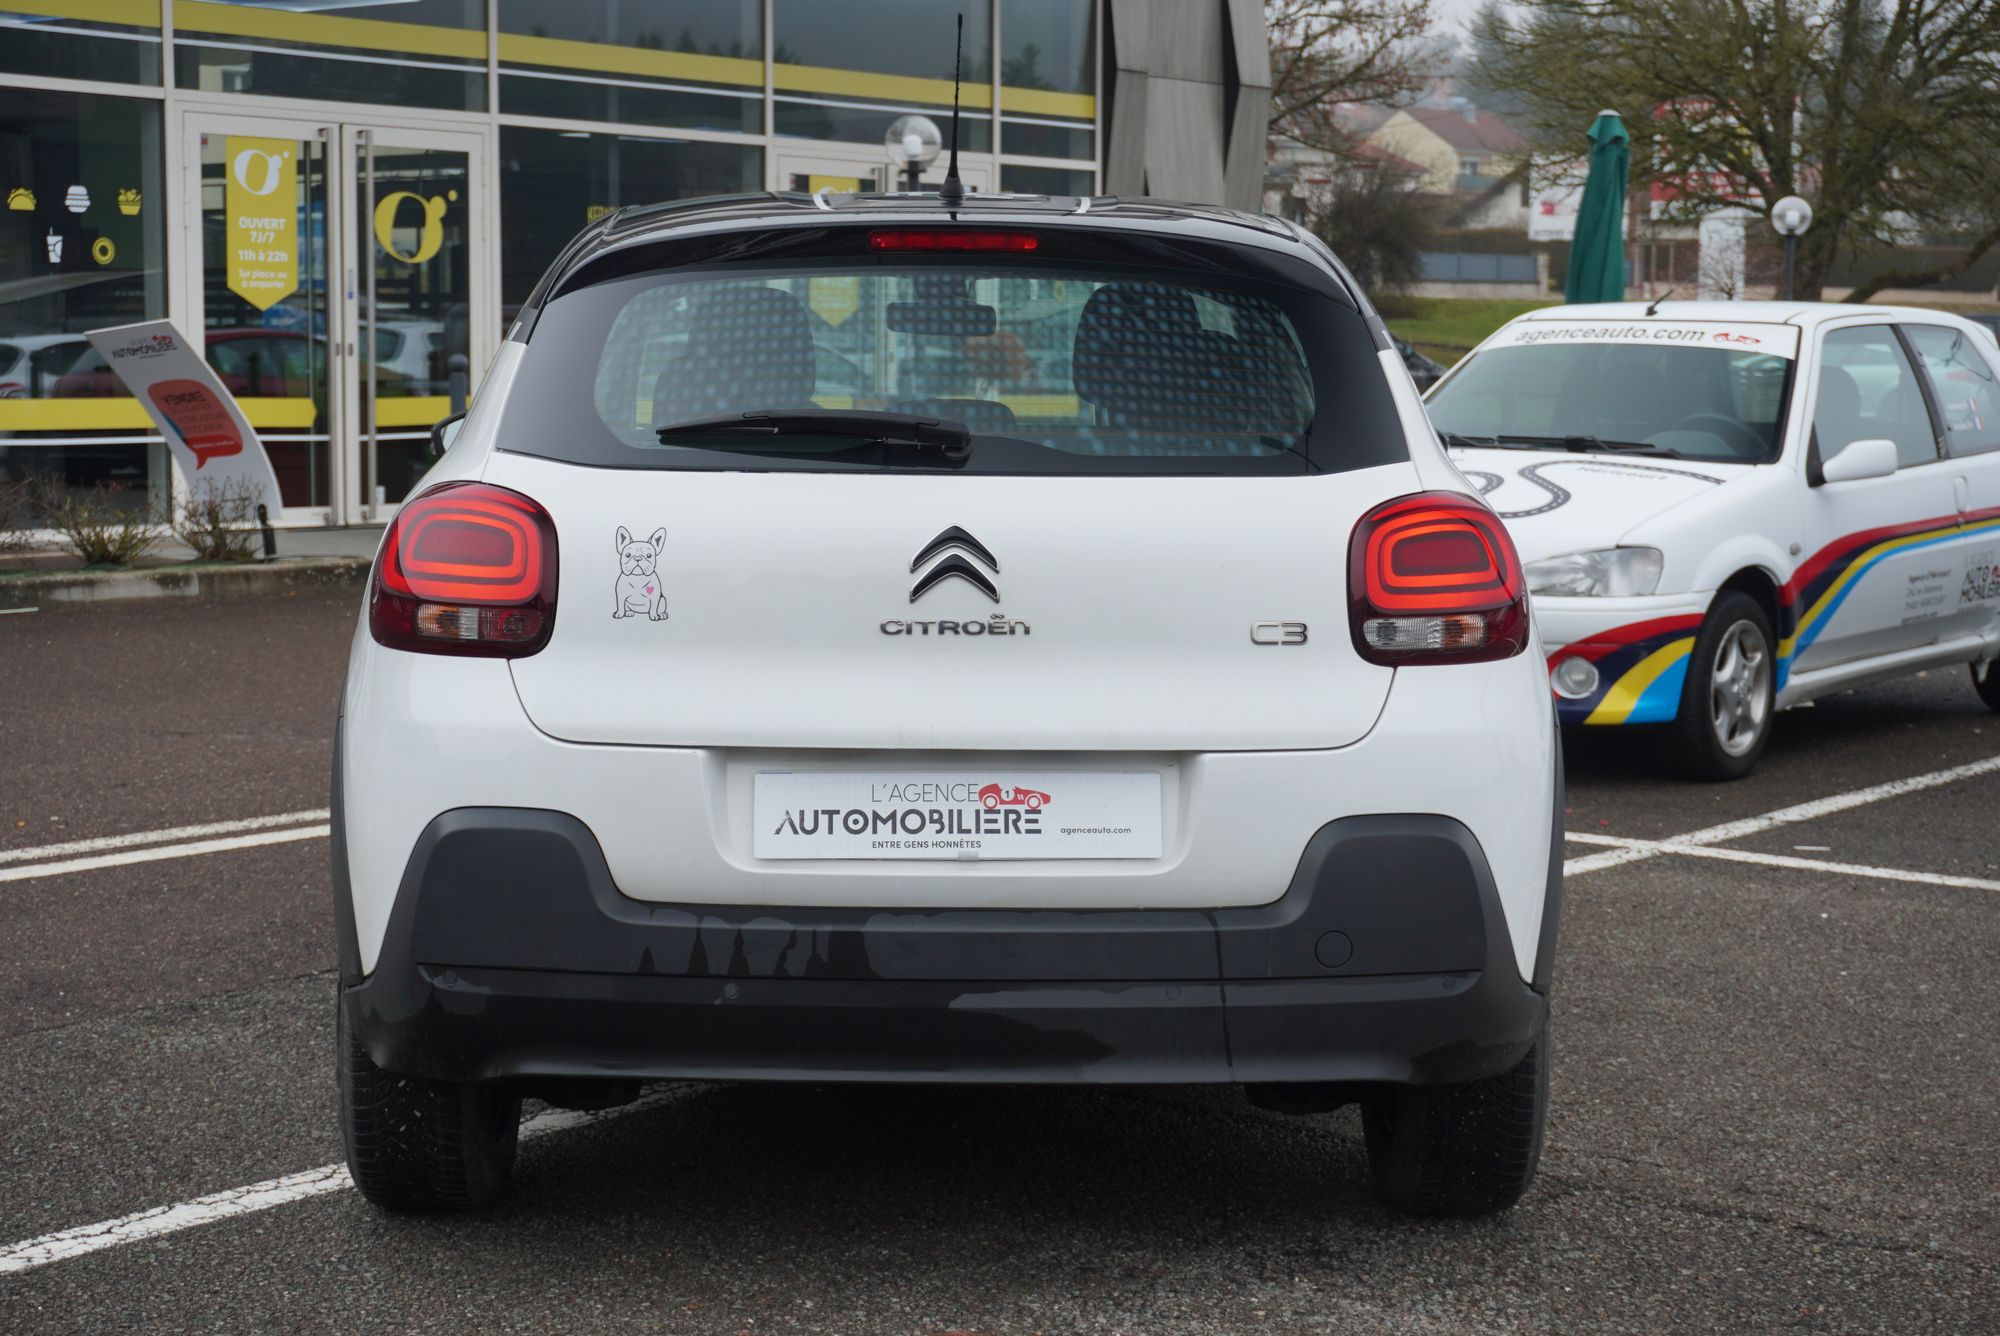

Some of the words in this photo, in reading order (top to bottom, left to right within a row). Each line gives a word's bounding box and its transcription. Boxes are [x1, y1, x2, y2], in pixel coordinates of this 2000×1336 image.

[238, 216, 286, 231] OUVERT
[238, 249, 256, 262] 11h
[258, 249, 265, 262] à
[267, 250, 289, 263] 22h
[1514, 326, 1706, 344] agenceauto.com
[1250, 620, 1309, 646] C3
[871, 783, 979, 803] L'AGENCE
[1004, 790, 1011, 799] 1
[1060, 826, 1132, 835] agenceauto.com
[872, 840, 901, 849] ENTRE
[903, 840, 929, 849] GENS
[931, 838, 982, 849] HONNÊTES
